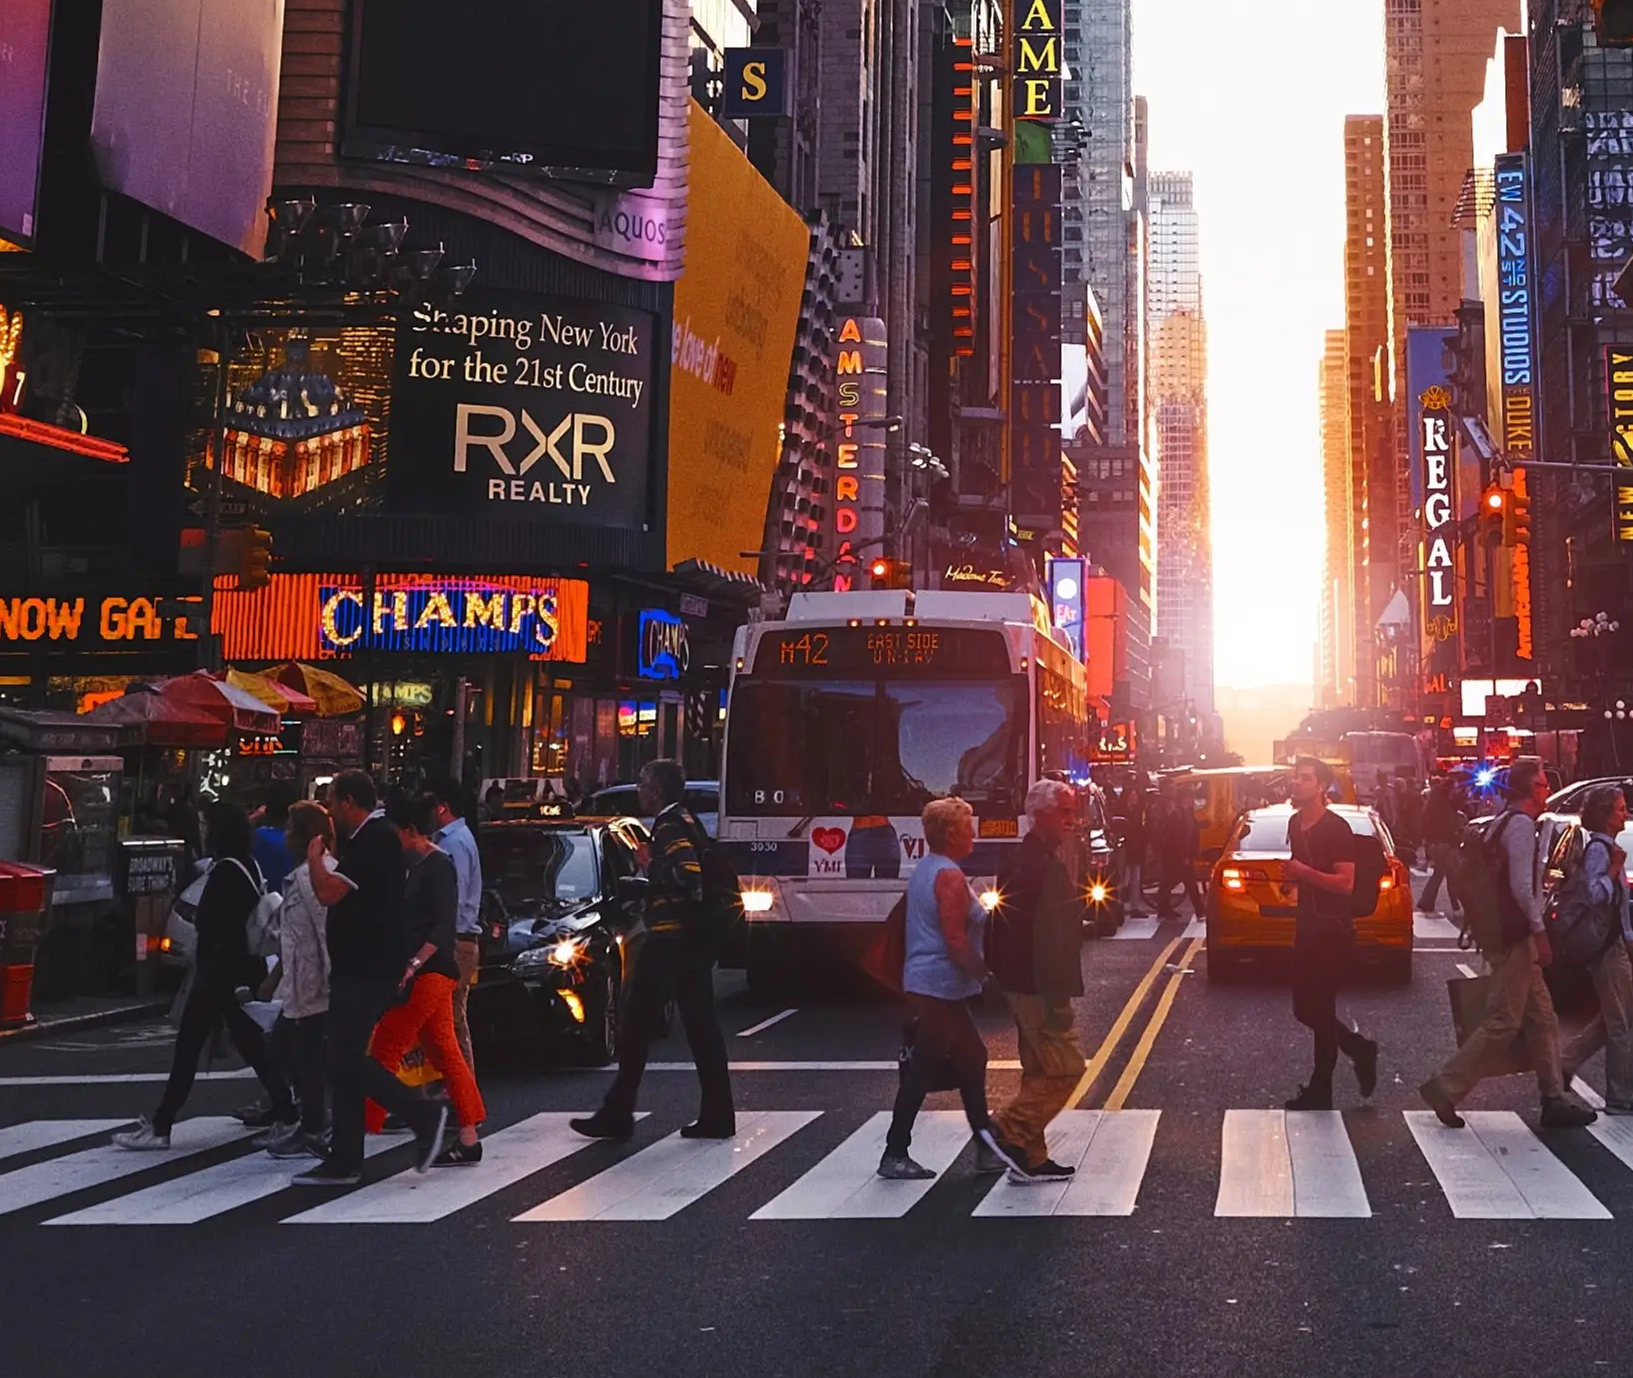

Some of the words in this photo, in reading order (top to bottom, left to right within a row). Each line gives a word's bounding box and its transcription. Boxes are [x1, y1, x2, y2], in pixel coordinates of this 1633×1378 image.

[598, 212, 667, 245] AQUOS
[539, 314, 595, 346] New
[598, 320, 638, 356] York
[1502, 289, 1531, 385] STUDIOS
[407, 350, 455, 380] for
[463, 353, 508, 385] the
[514, 358, 564, 390] 21st
[568, 365, 644, 409] Century
[453, 403, 617, 483] RXR
[487, 479, 593, 506] REALTY
[1422, 417, 1452, 607] REGAL
[320, 588, 558, 647] CHAMPS
[647, 618, 691, 673] CHAMPS
[779, 634, 829, 666] M42
[907, 633, 940, 650] SIDE
